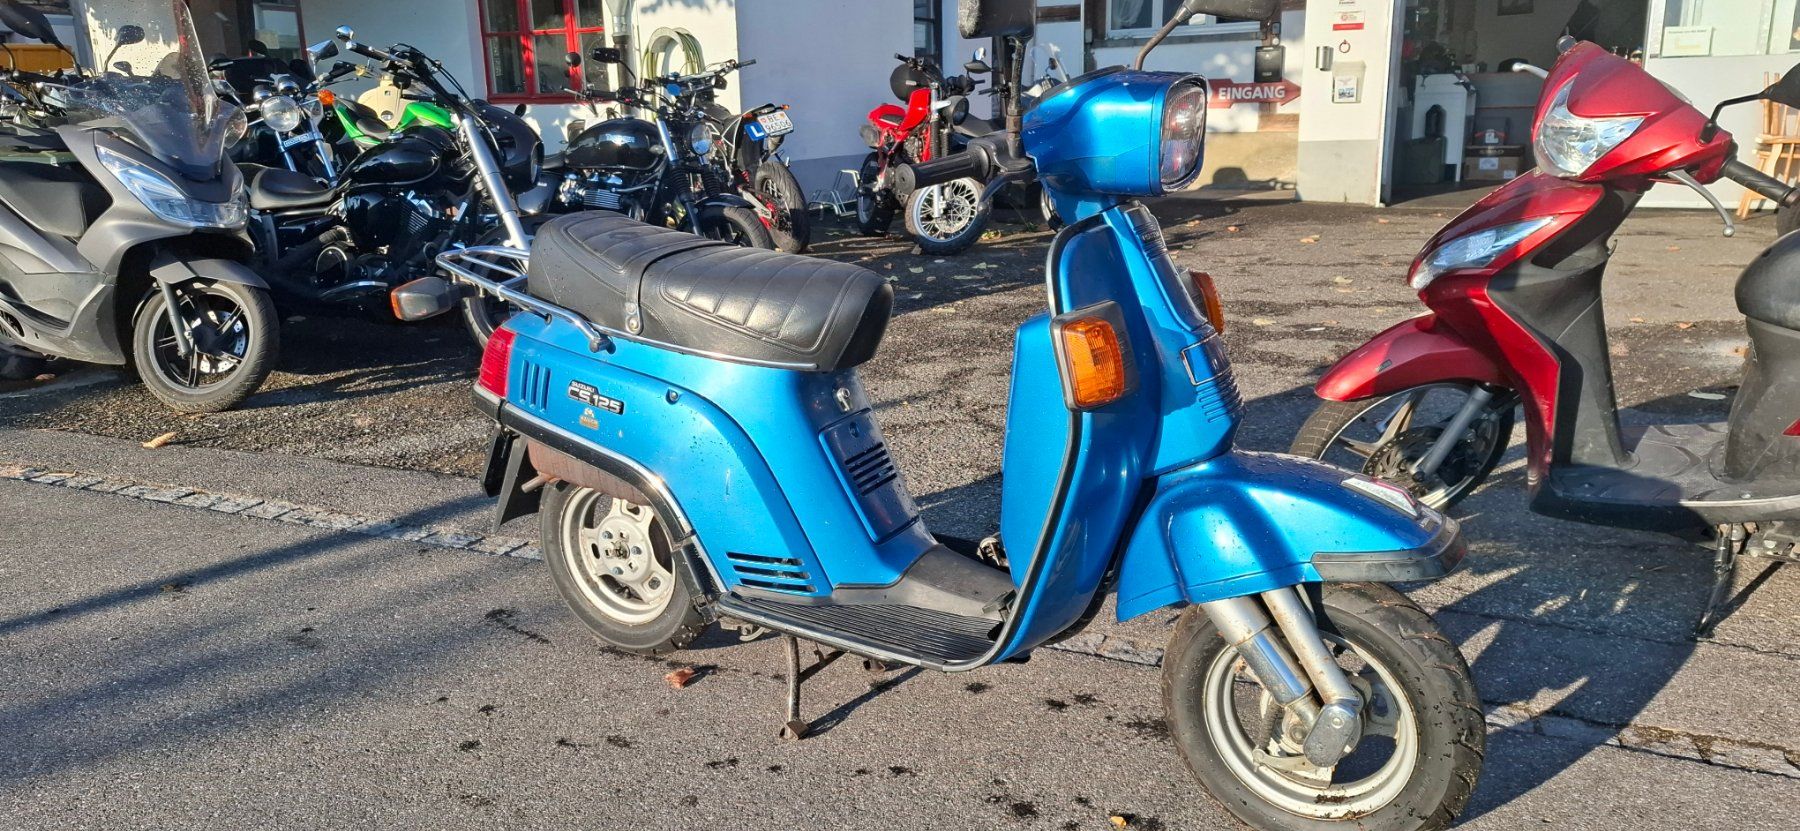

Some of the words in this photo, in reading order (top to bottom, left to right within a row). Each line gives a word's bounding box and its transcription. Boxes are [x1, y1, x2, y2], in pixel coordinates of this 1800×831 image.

[1218, 86, 1286, 100] EINGANG
[750, 126, 765, 137] L
[571, 381, 595, 393] SUZUKI
